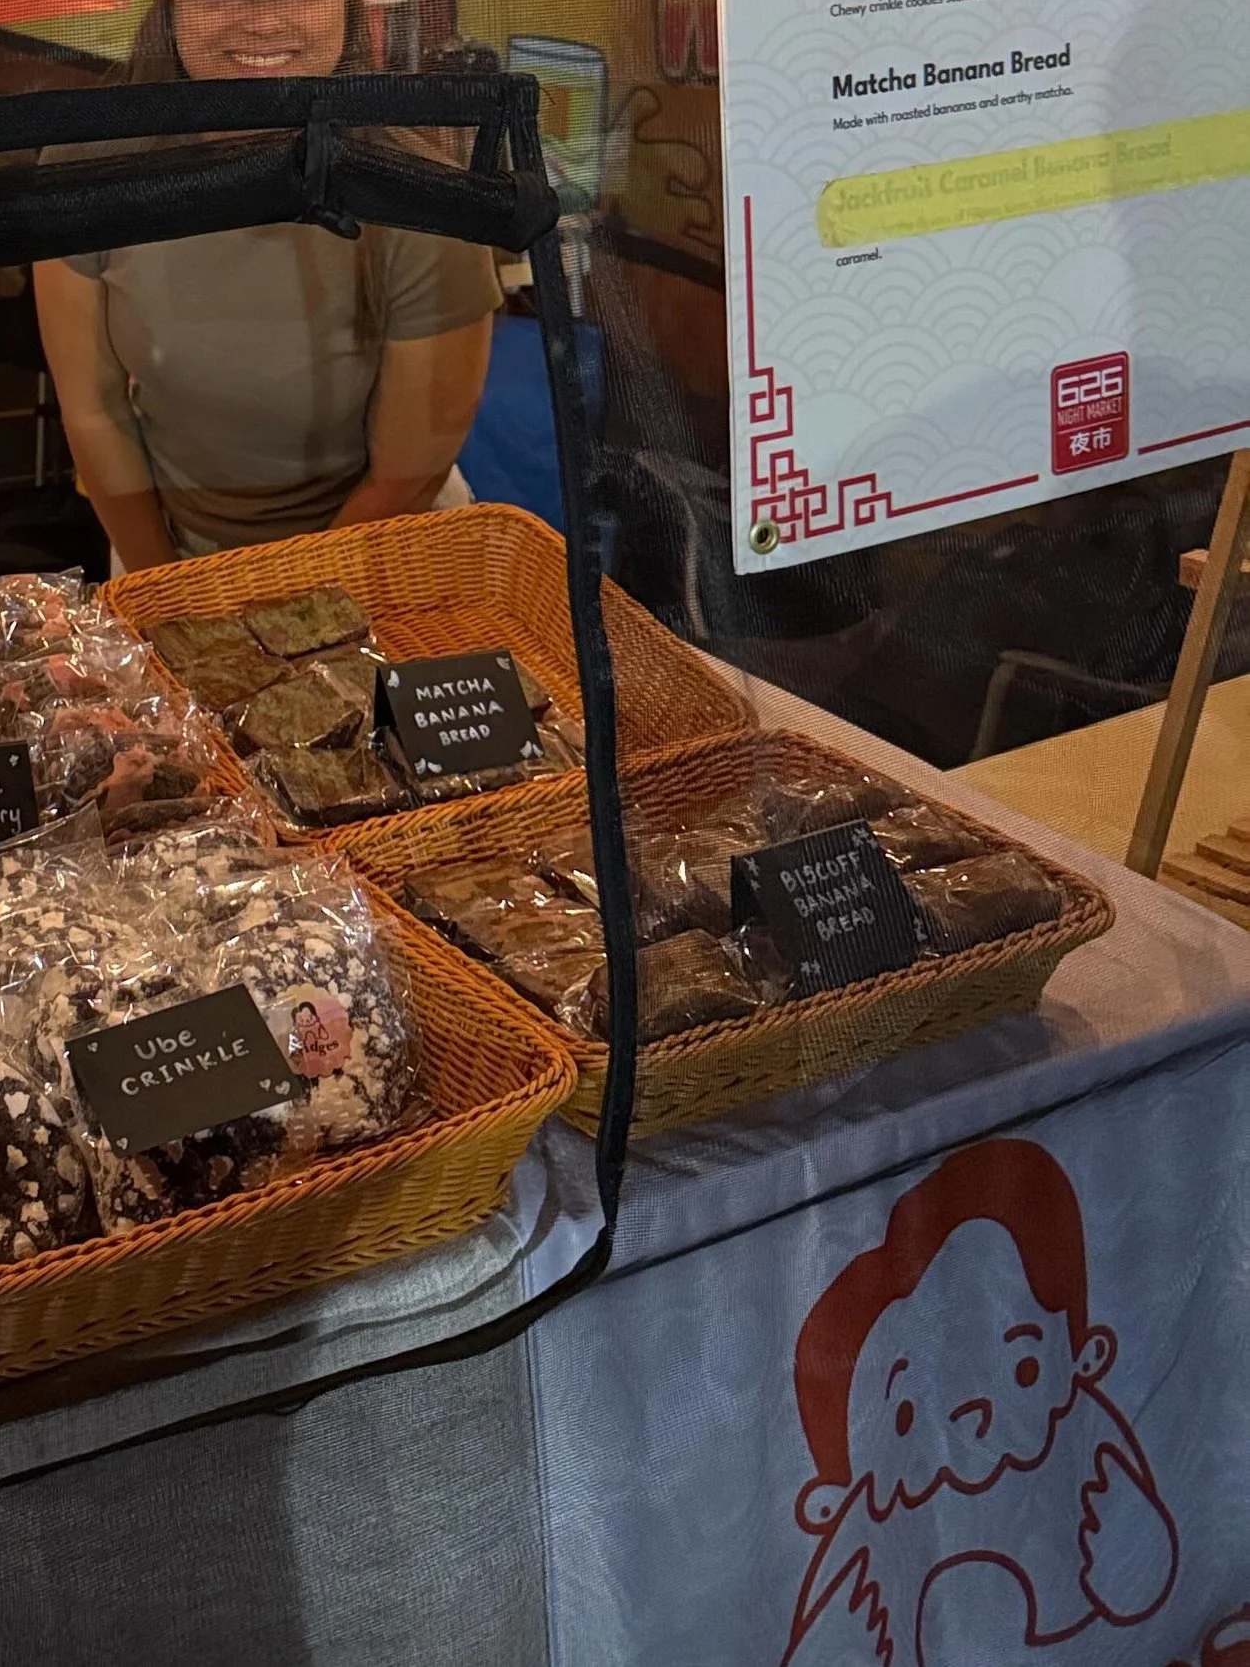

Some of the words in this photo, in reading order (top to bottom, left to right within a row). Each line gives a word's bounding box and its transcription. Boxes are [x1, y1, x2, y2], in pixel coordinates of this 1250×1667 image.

[830, 3, 866, 18] Chewy
[832, 67, 917, 99] Matcha
[923, 59, 1005, 87] Banana
[1011, 42, 1071, 74] Bread
[833, 115, 863, 131] Made
[866, 112, 888, 127] with
[890, 105, 931, 122] roasted
[932, 101, 977, 116] bananas
[978, 94, 999, 109] and
[1000, 90, 1033, 105] earthy
[1034, 84, 1074, 100] matcha.
[938, 161, 1029, 195] Caramel
[836, 248, 883, 268] caramel.
[1058, 366, 1123, 408] 626
[1057, 406, 1085, 426] NIGHT
[1086, 396, 1123, 419] MARKET
[1069, 427, 1112, 456] 夜市
[415, 677, 495, 701] MATCHA
[414, 700, 504, 729] BANANA
[438, 724, 491, 746] BREAD
[779, 851, 862, 893] BISCOFF
[793, 873, 876, 918] BANANA
[816, 907, 876, 942] BREAD
[134, 1030, 197, 1060] Ube
[121, 1038, 250, 1096] CRINKLE
